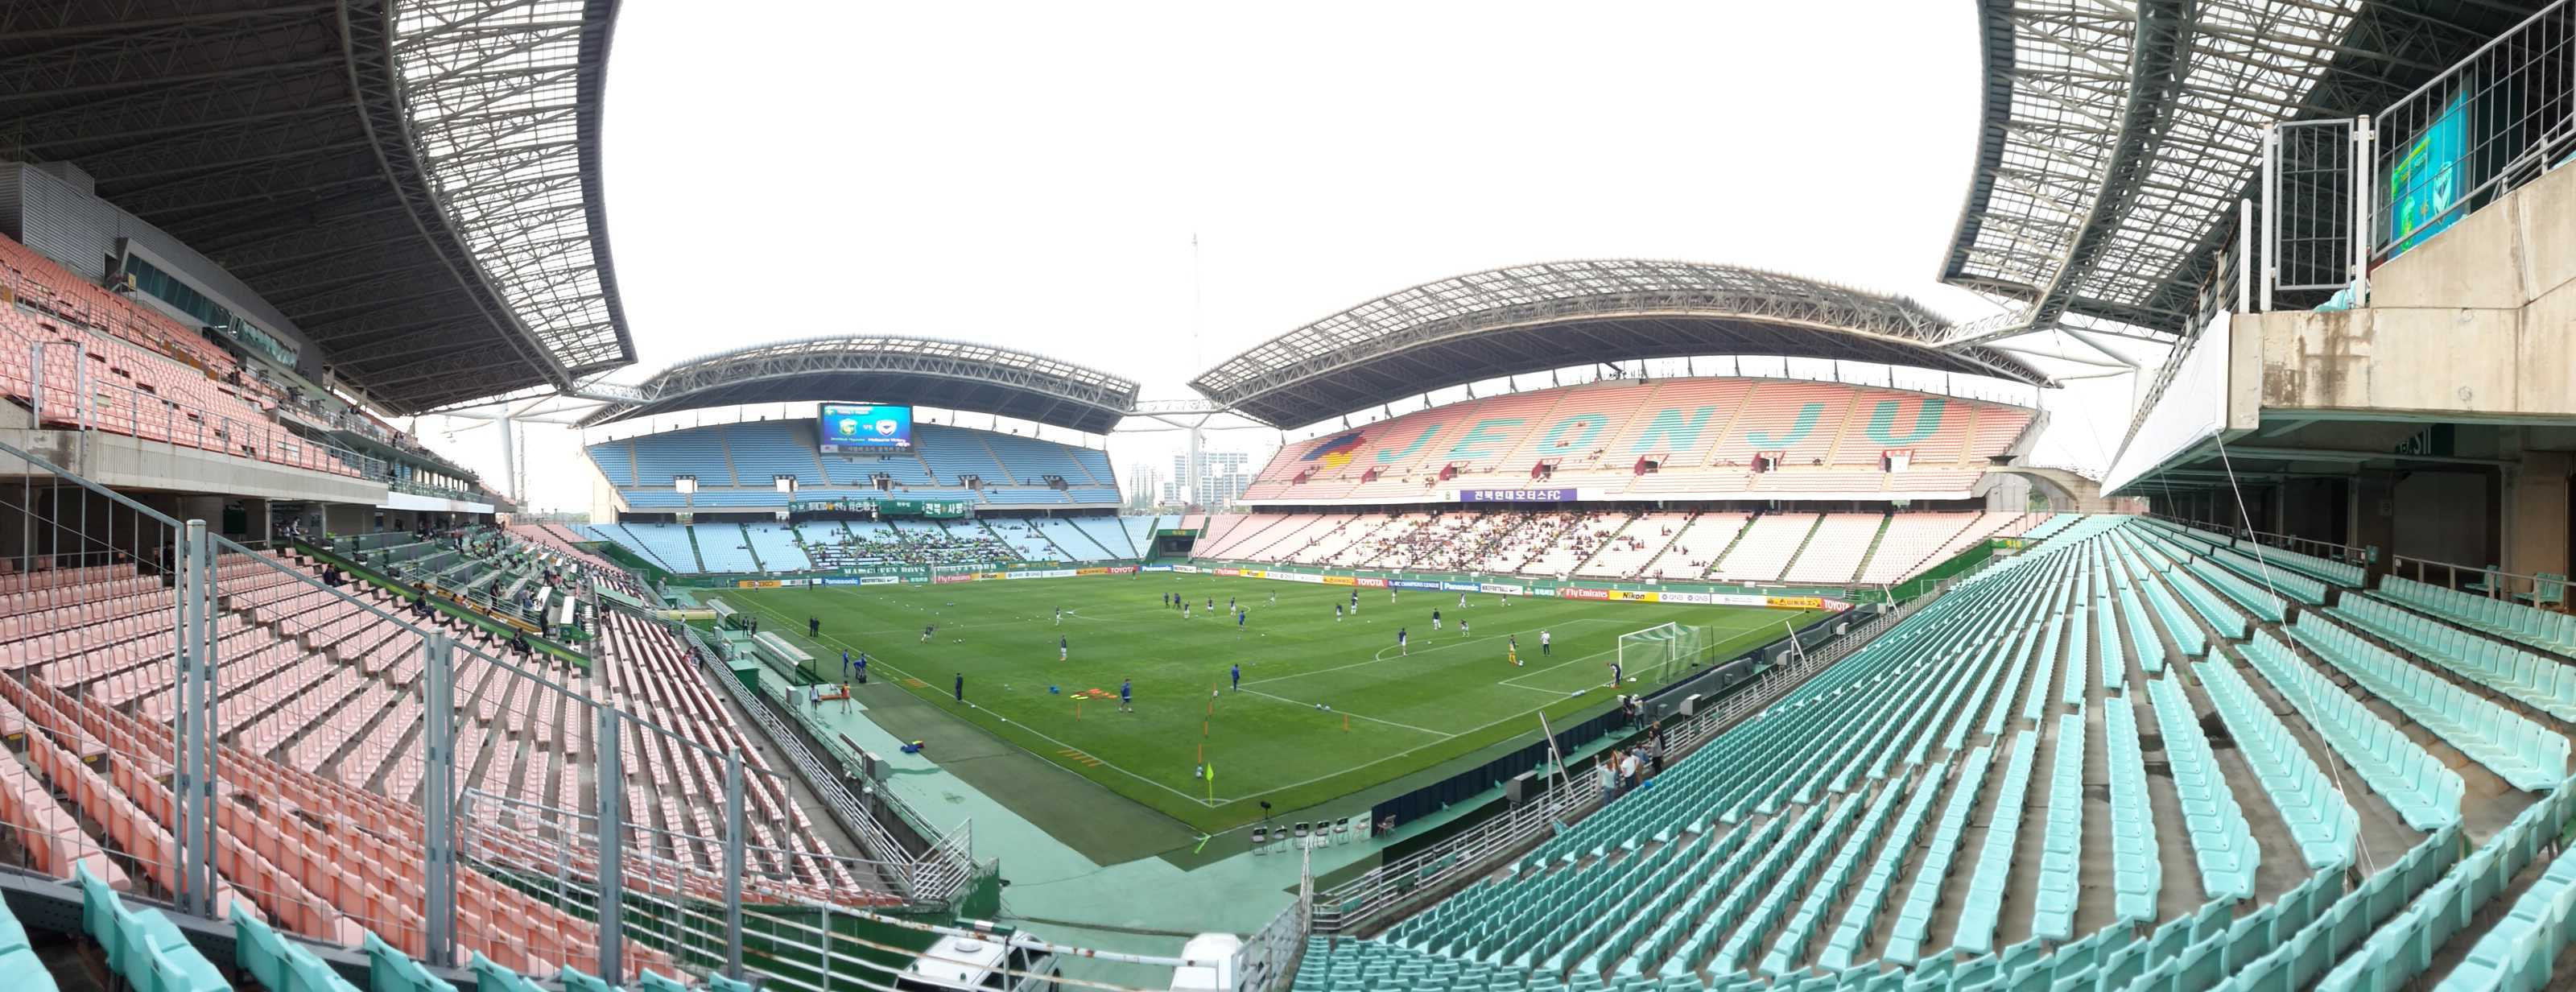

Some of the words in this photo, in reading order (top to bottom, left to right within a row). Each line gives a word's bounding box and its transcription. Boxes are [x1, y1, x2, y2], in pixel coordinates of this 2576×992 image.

[1377, 399, 1946, 464] JEONJU
[1357, 578, 1384, 586] TOYOTA
[1444, 582, 1480, 591] Panasonic
[1566, 588, 1578, 597] Fly
[1579, 589, 1608, 597] Emirates
[1622, 592, 1645, 600] Nikon
